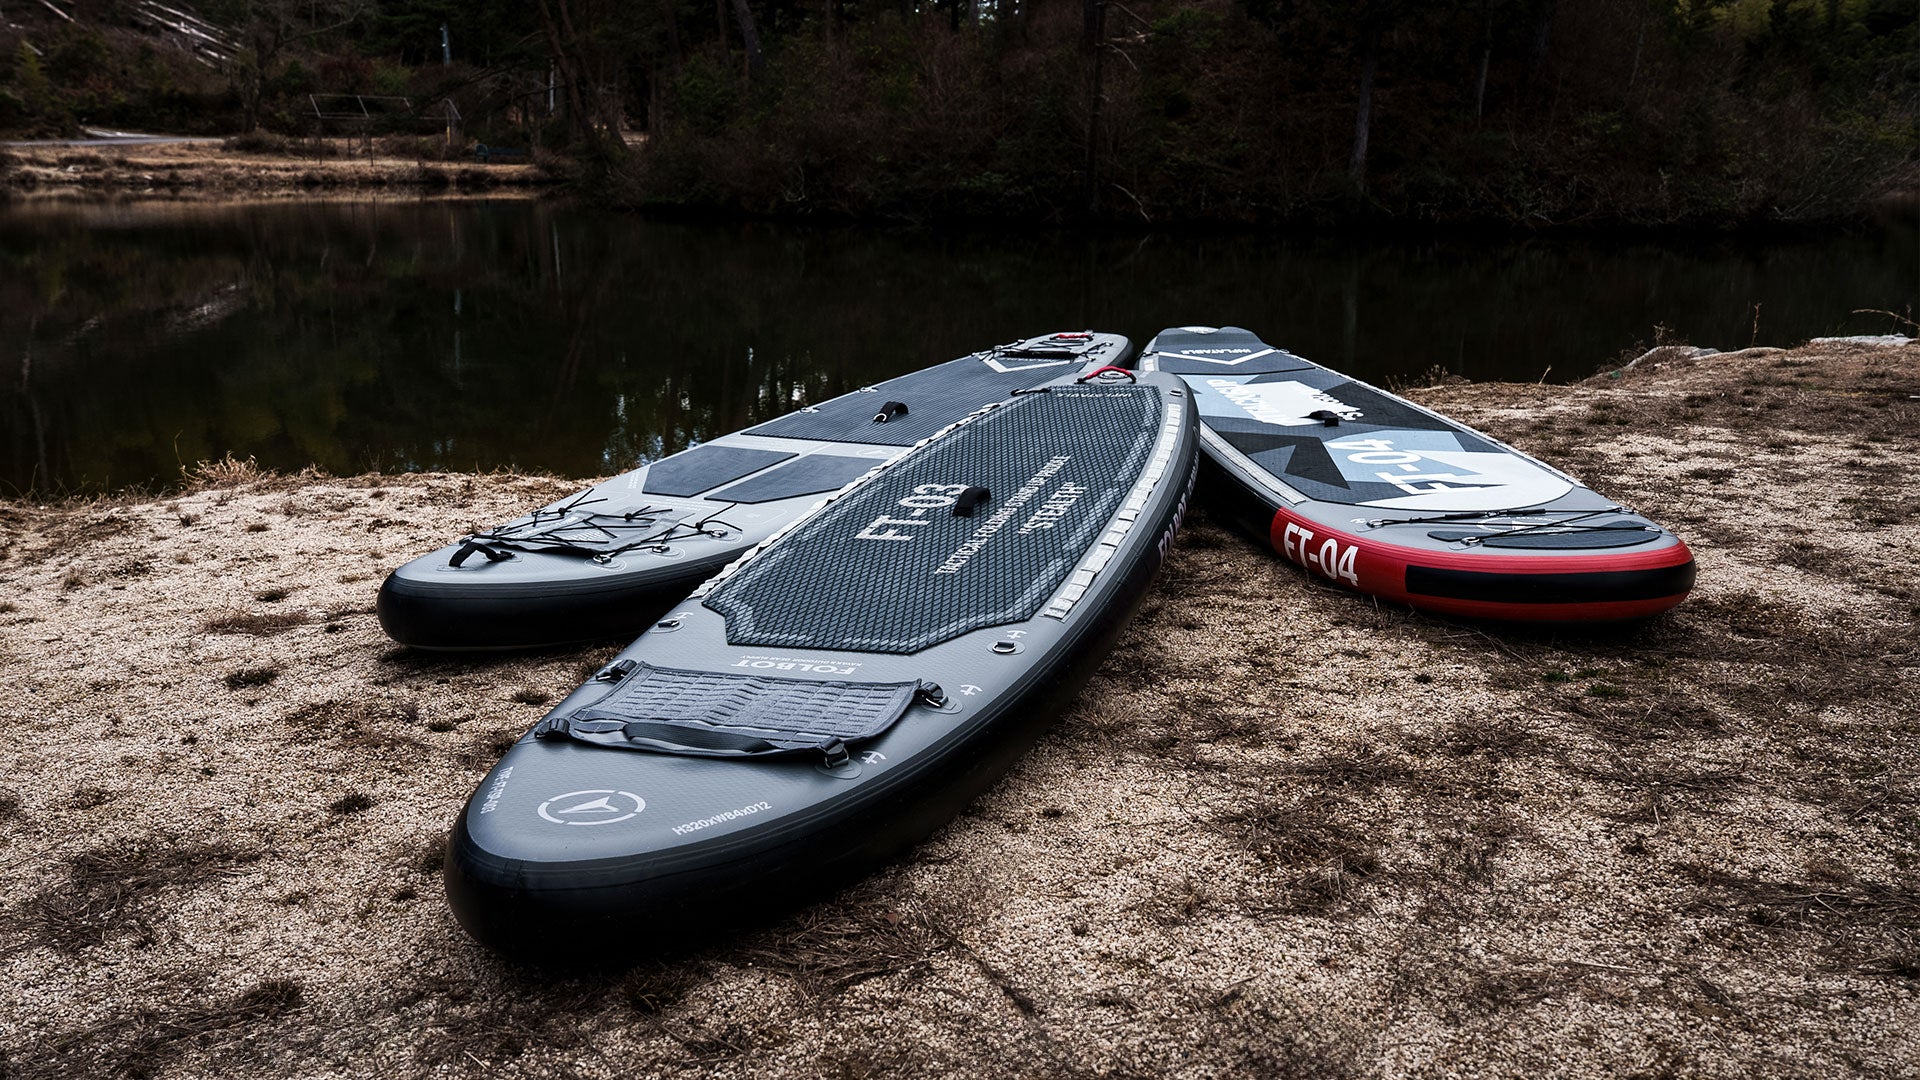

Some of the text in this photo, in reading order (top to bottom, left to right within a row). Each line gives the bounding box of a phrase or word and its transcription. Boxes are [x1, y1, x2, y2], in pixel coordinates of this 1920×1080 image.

[1327, 439, 1483, 495] FT-04
[854, 483, 970, 541] FT-03
[934, 538, 988, 574] TACTICAL
[1283, 521, 1359, 587] FT-04
[730, 659, 857, 675] FOLBOT
[671, 801, 773, 836] H320xW84xD12
